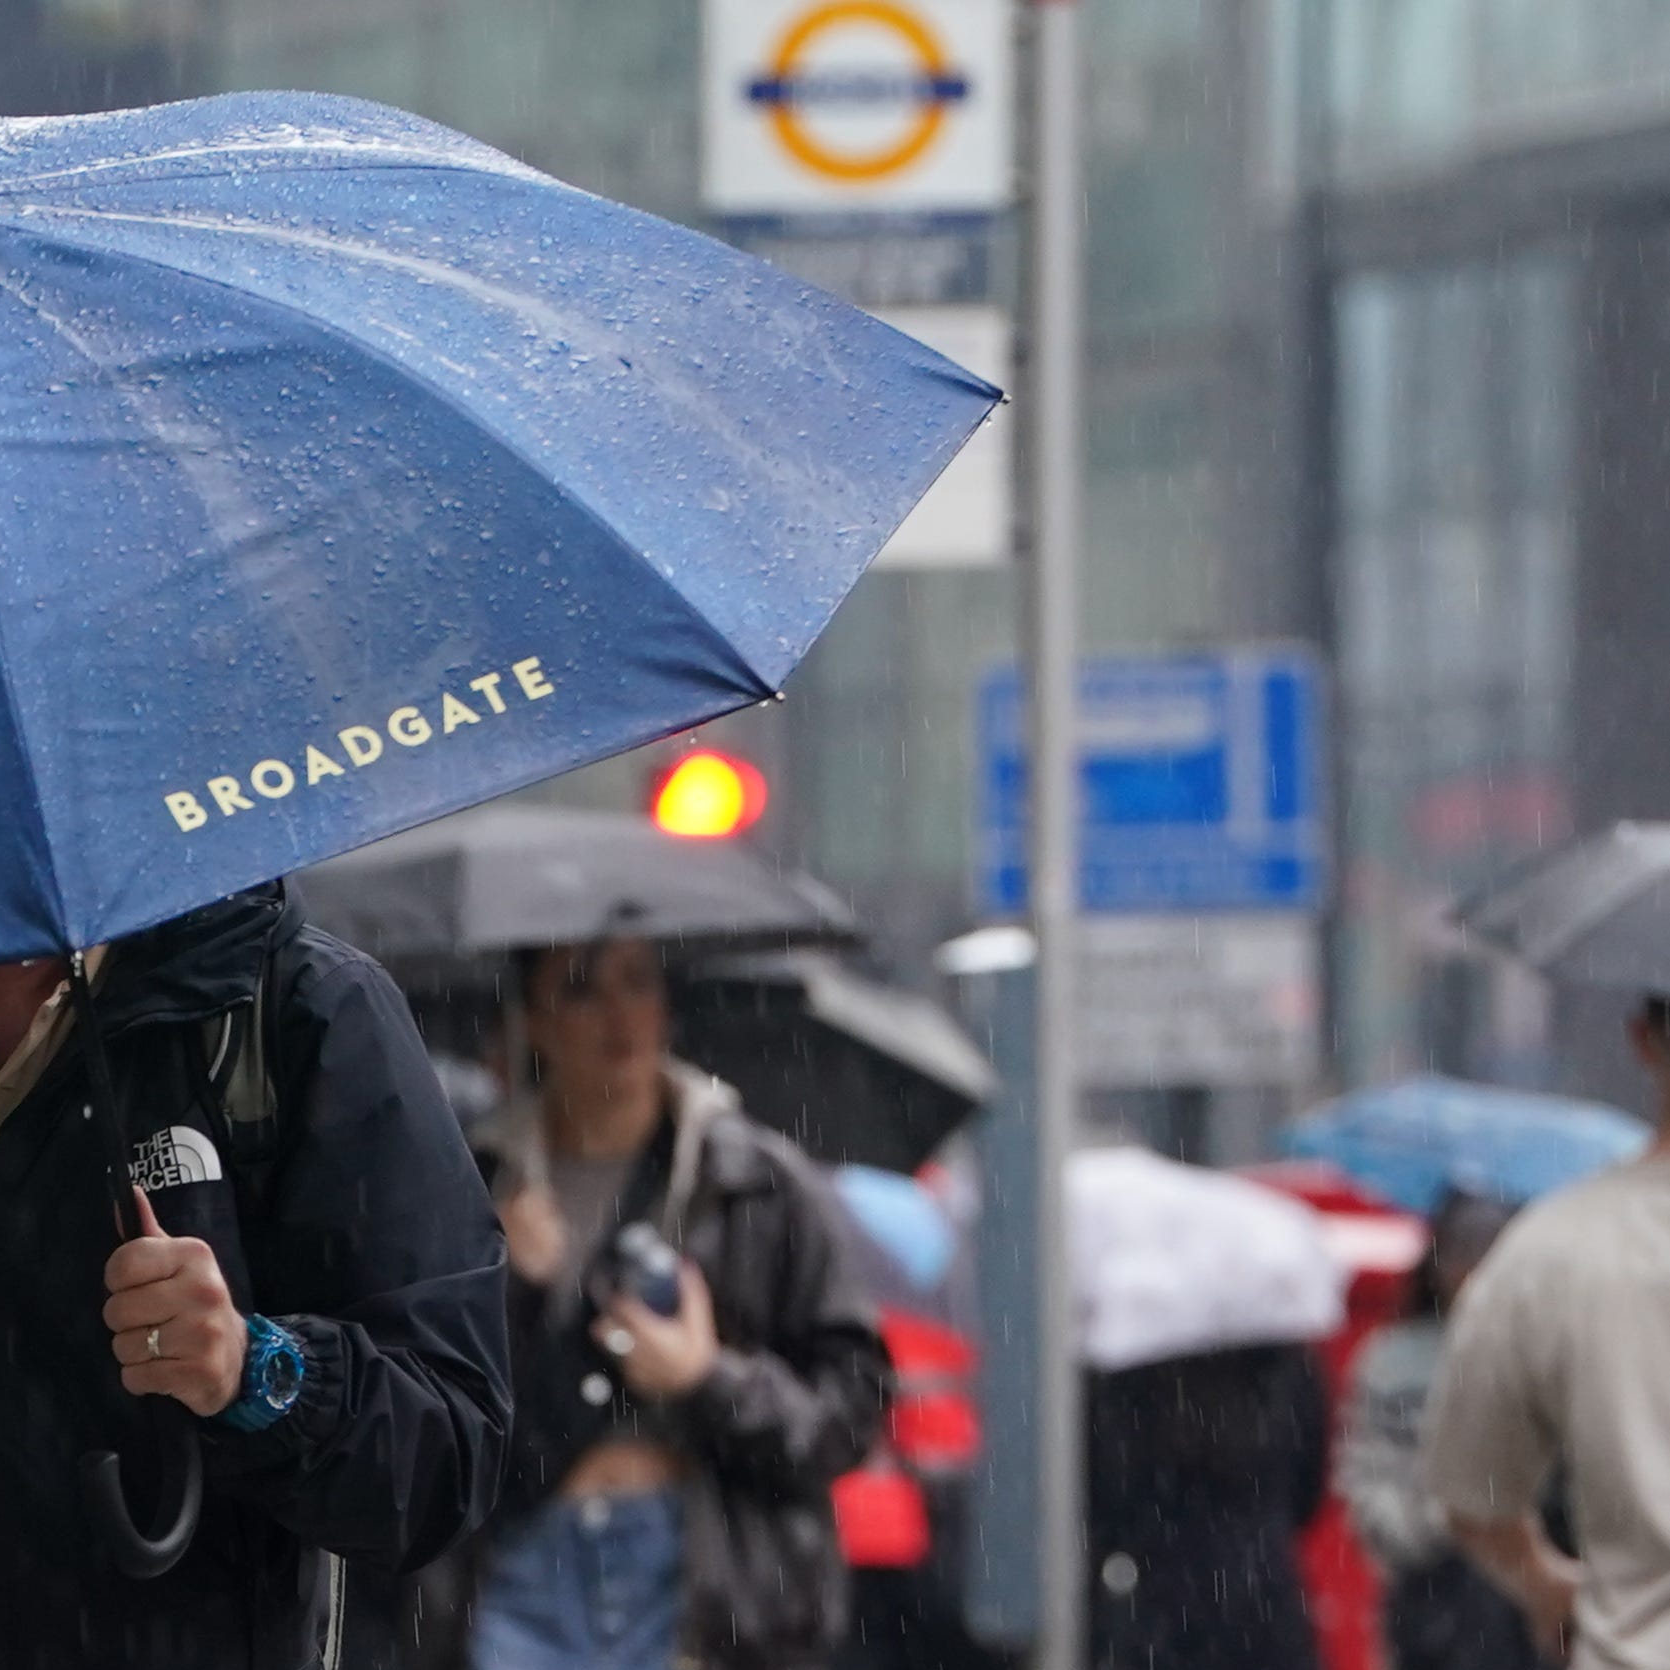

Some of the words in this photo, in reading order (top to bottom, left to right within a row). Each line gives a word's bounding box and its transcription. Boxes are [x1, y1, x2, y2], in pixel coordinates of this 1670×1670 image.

[164, 656, 555, 833] BROADGATE
[133, 1128, 172, 1160] THE
[127, 1147, 177, 1179] RTH
